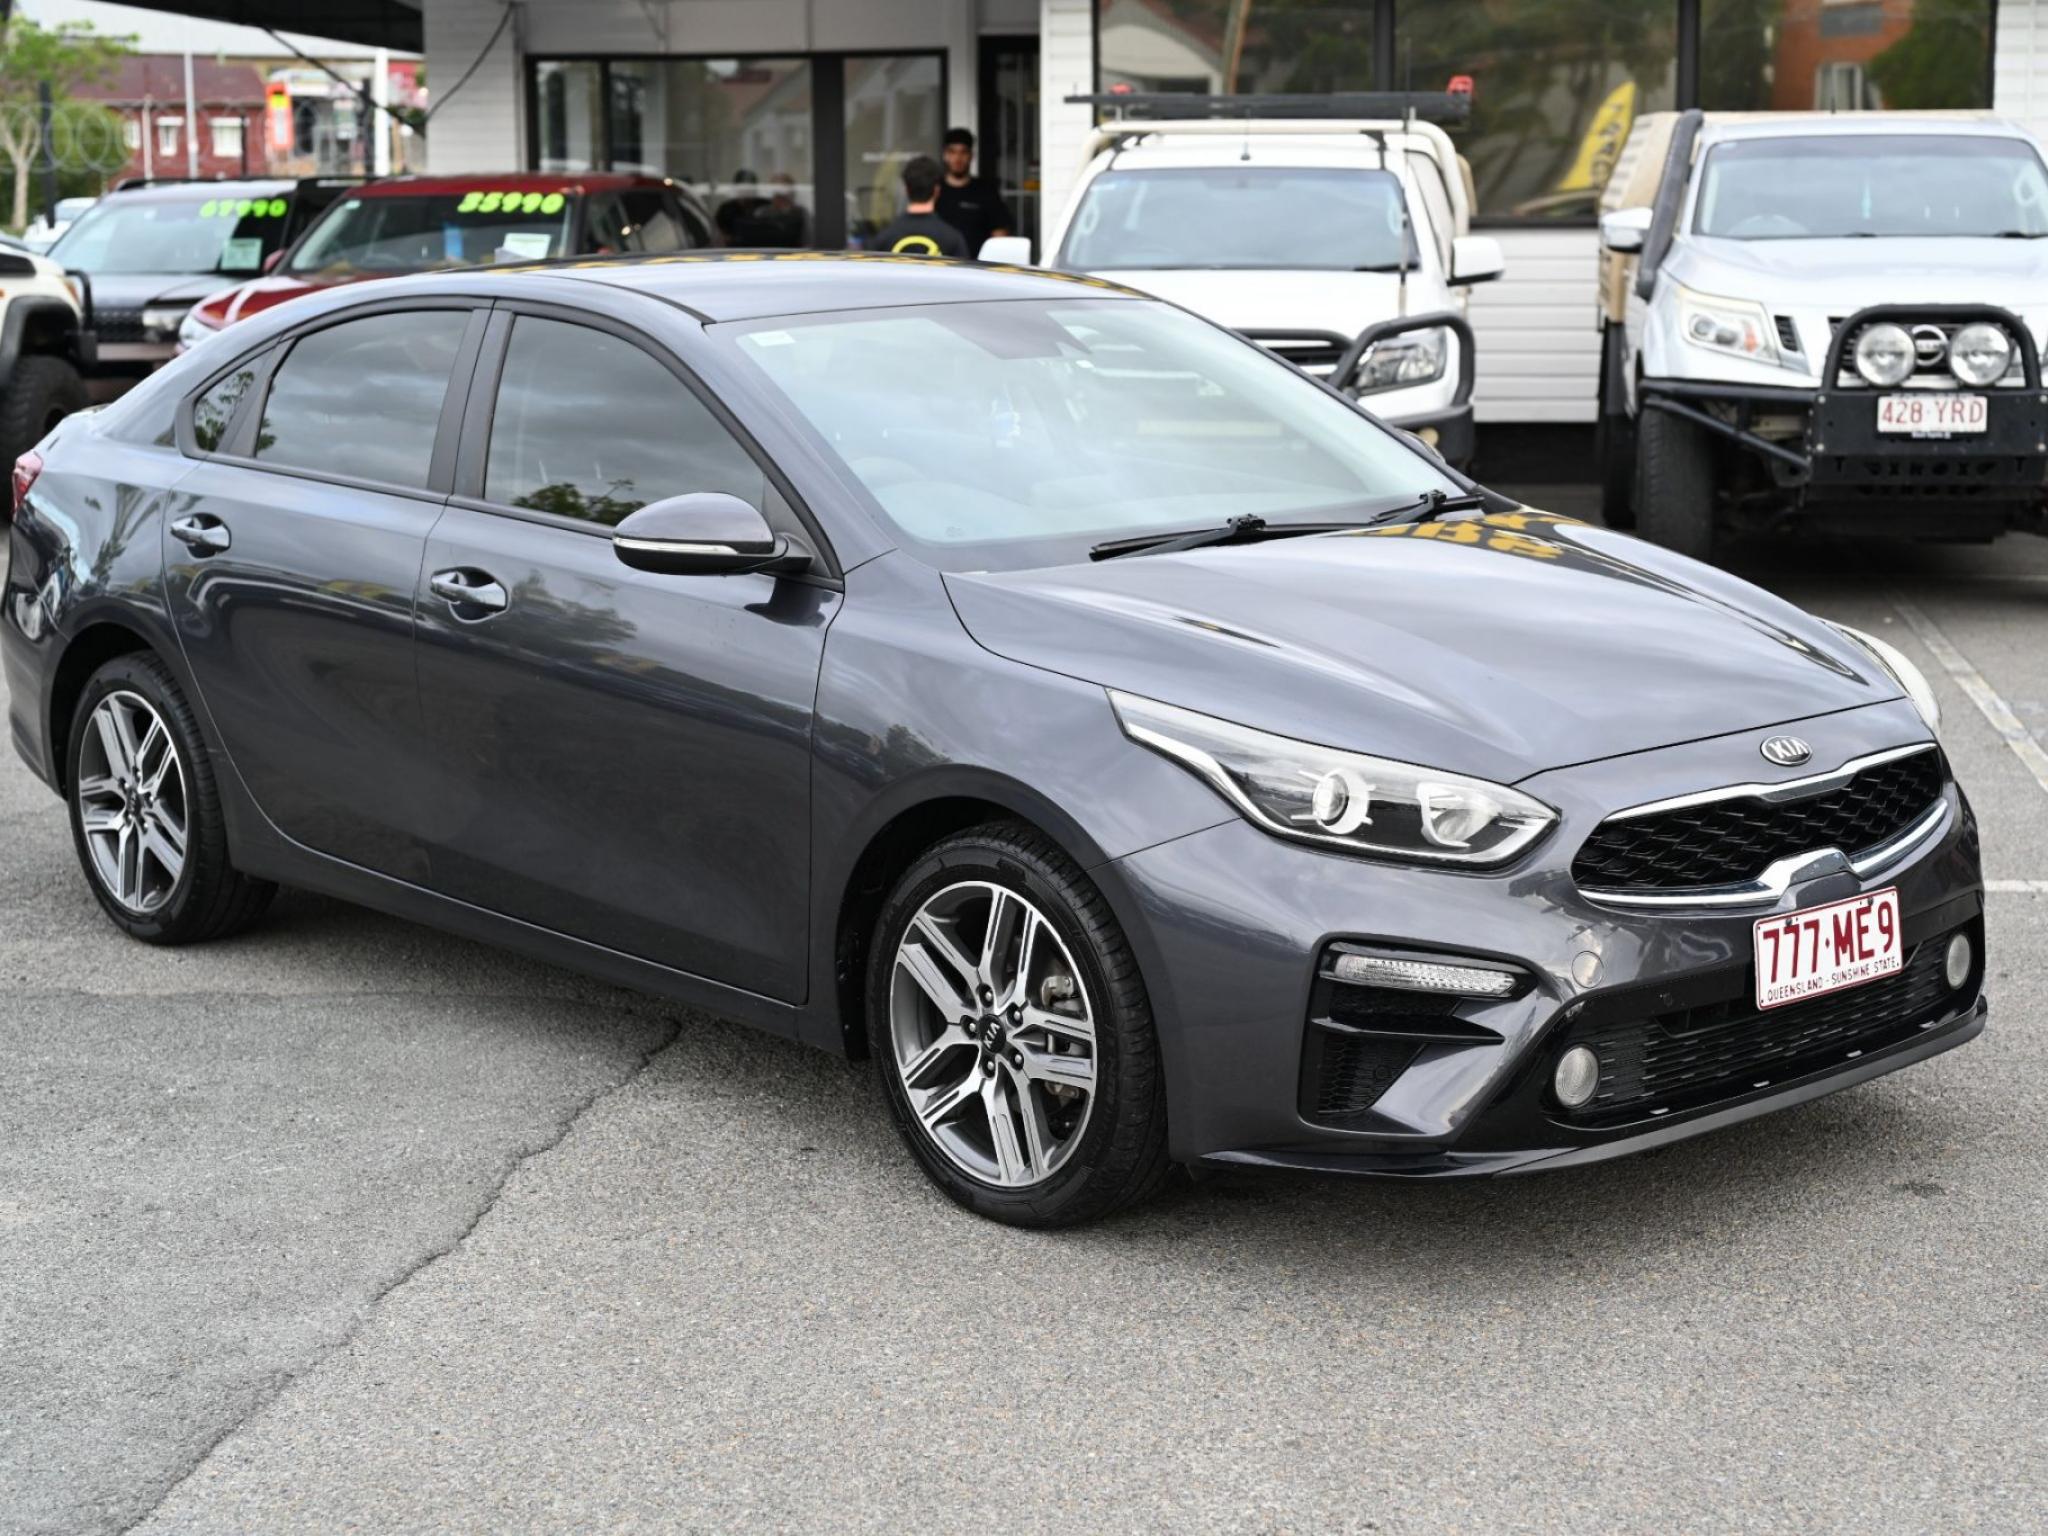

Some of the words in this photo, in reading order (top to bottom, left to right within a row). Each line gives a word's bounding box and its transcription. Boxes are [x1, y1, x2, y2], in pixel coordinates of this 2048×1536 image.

[1768, 739, 1809, 759] KIA
[1767, 976, 1823, 1002] QUEENSLAND
[1831, 963, 1870, 986] SUNSHINE
